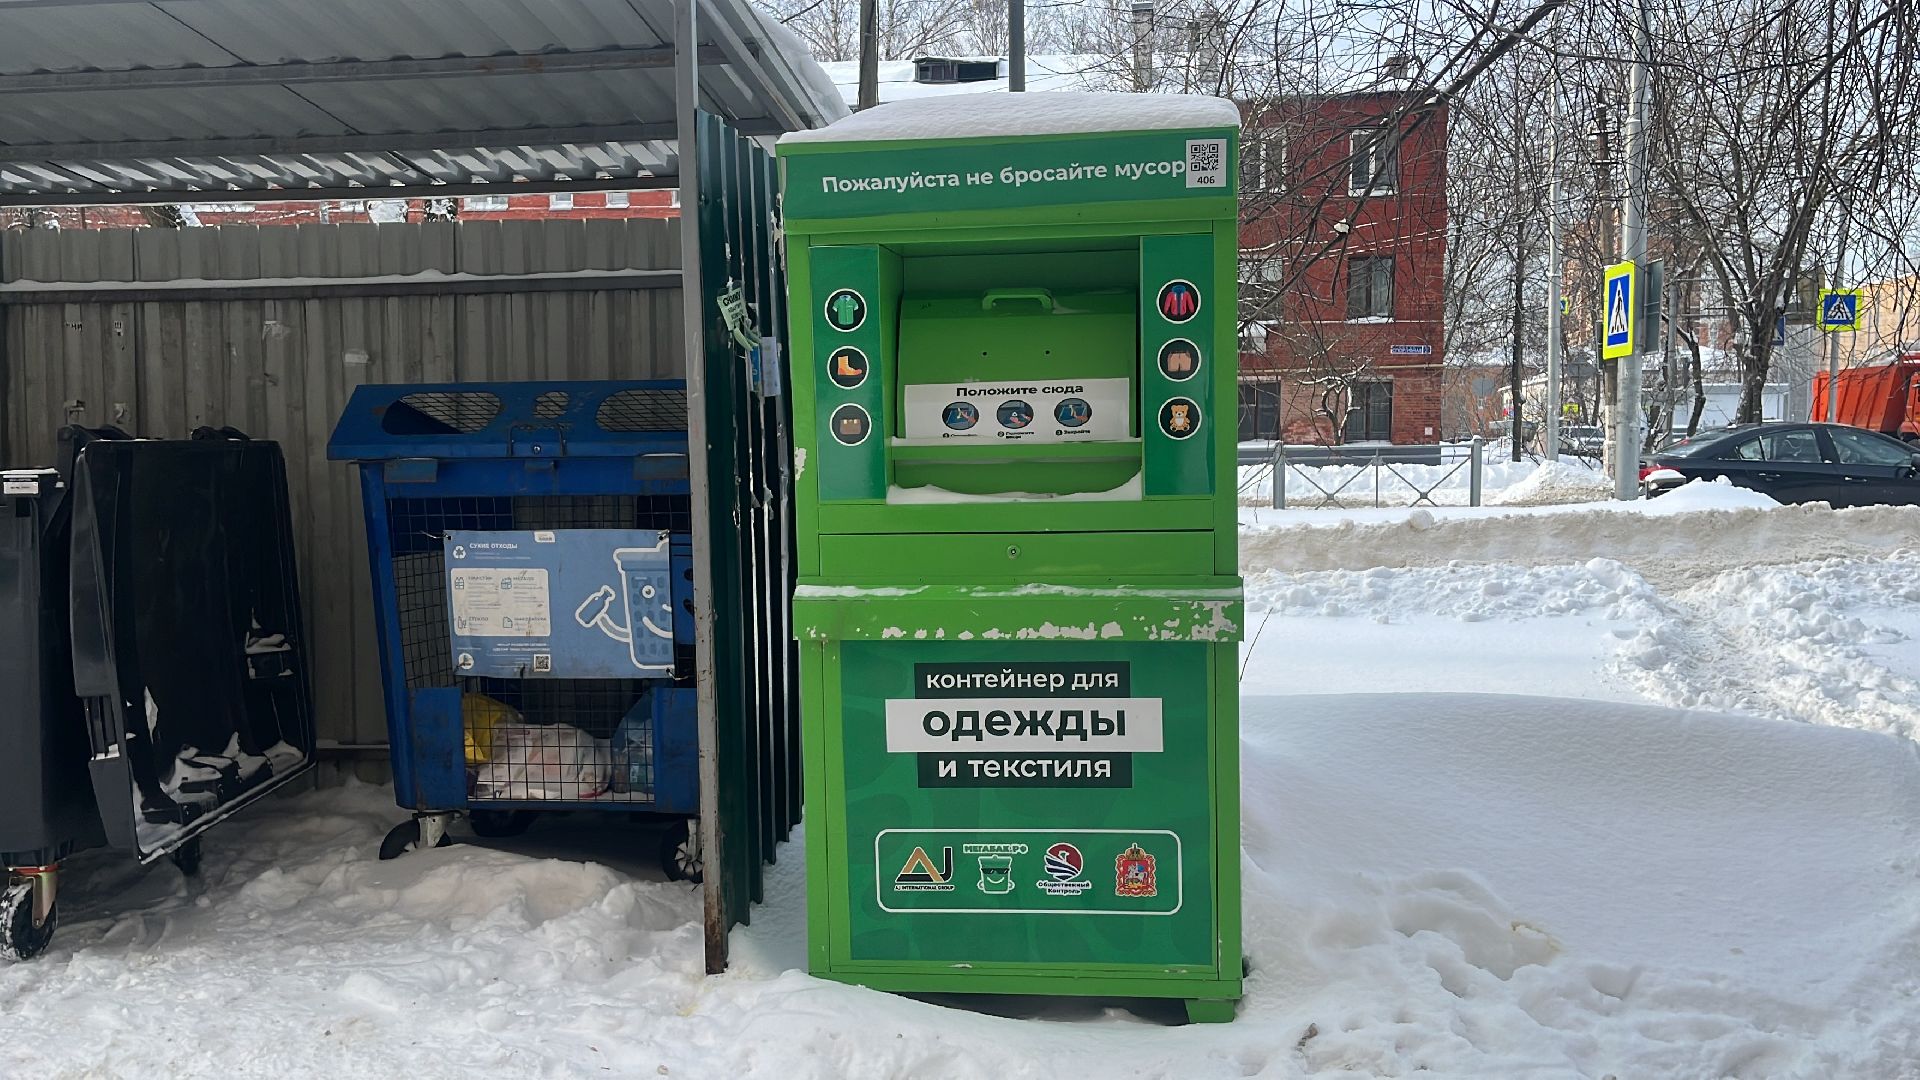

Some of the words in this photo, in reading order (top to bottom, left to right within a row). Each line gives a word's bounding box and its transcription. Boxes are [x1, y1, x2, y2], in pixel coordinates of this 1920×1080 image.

[822, 172, 960, 194] Пожалуйста
[966, 169, 993, 185] не
[998, 164, 1108, 187] бросайте
[1114, 159, 1185, 179] мусор
[1197, 176, 1216, 185] 406
[956, 387, 1037, 397] Положите
[1042, 384, 1084, 396] сюда
[926, 669, 1065, 691] контейнер
[1071, 670, 1119, 690] для
[922, 709, 1126, 742] одежды
[938, 761, 957, 778] и
[968, 758, 1111, 778] текстиля
[1038, 881, 1091, 889] Общественный
